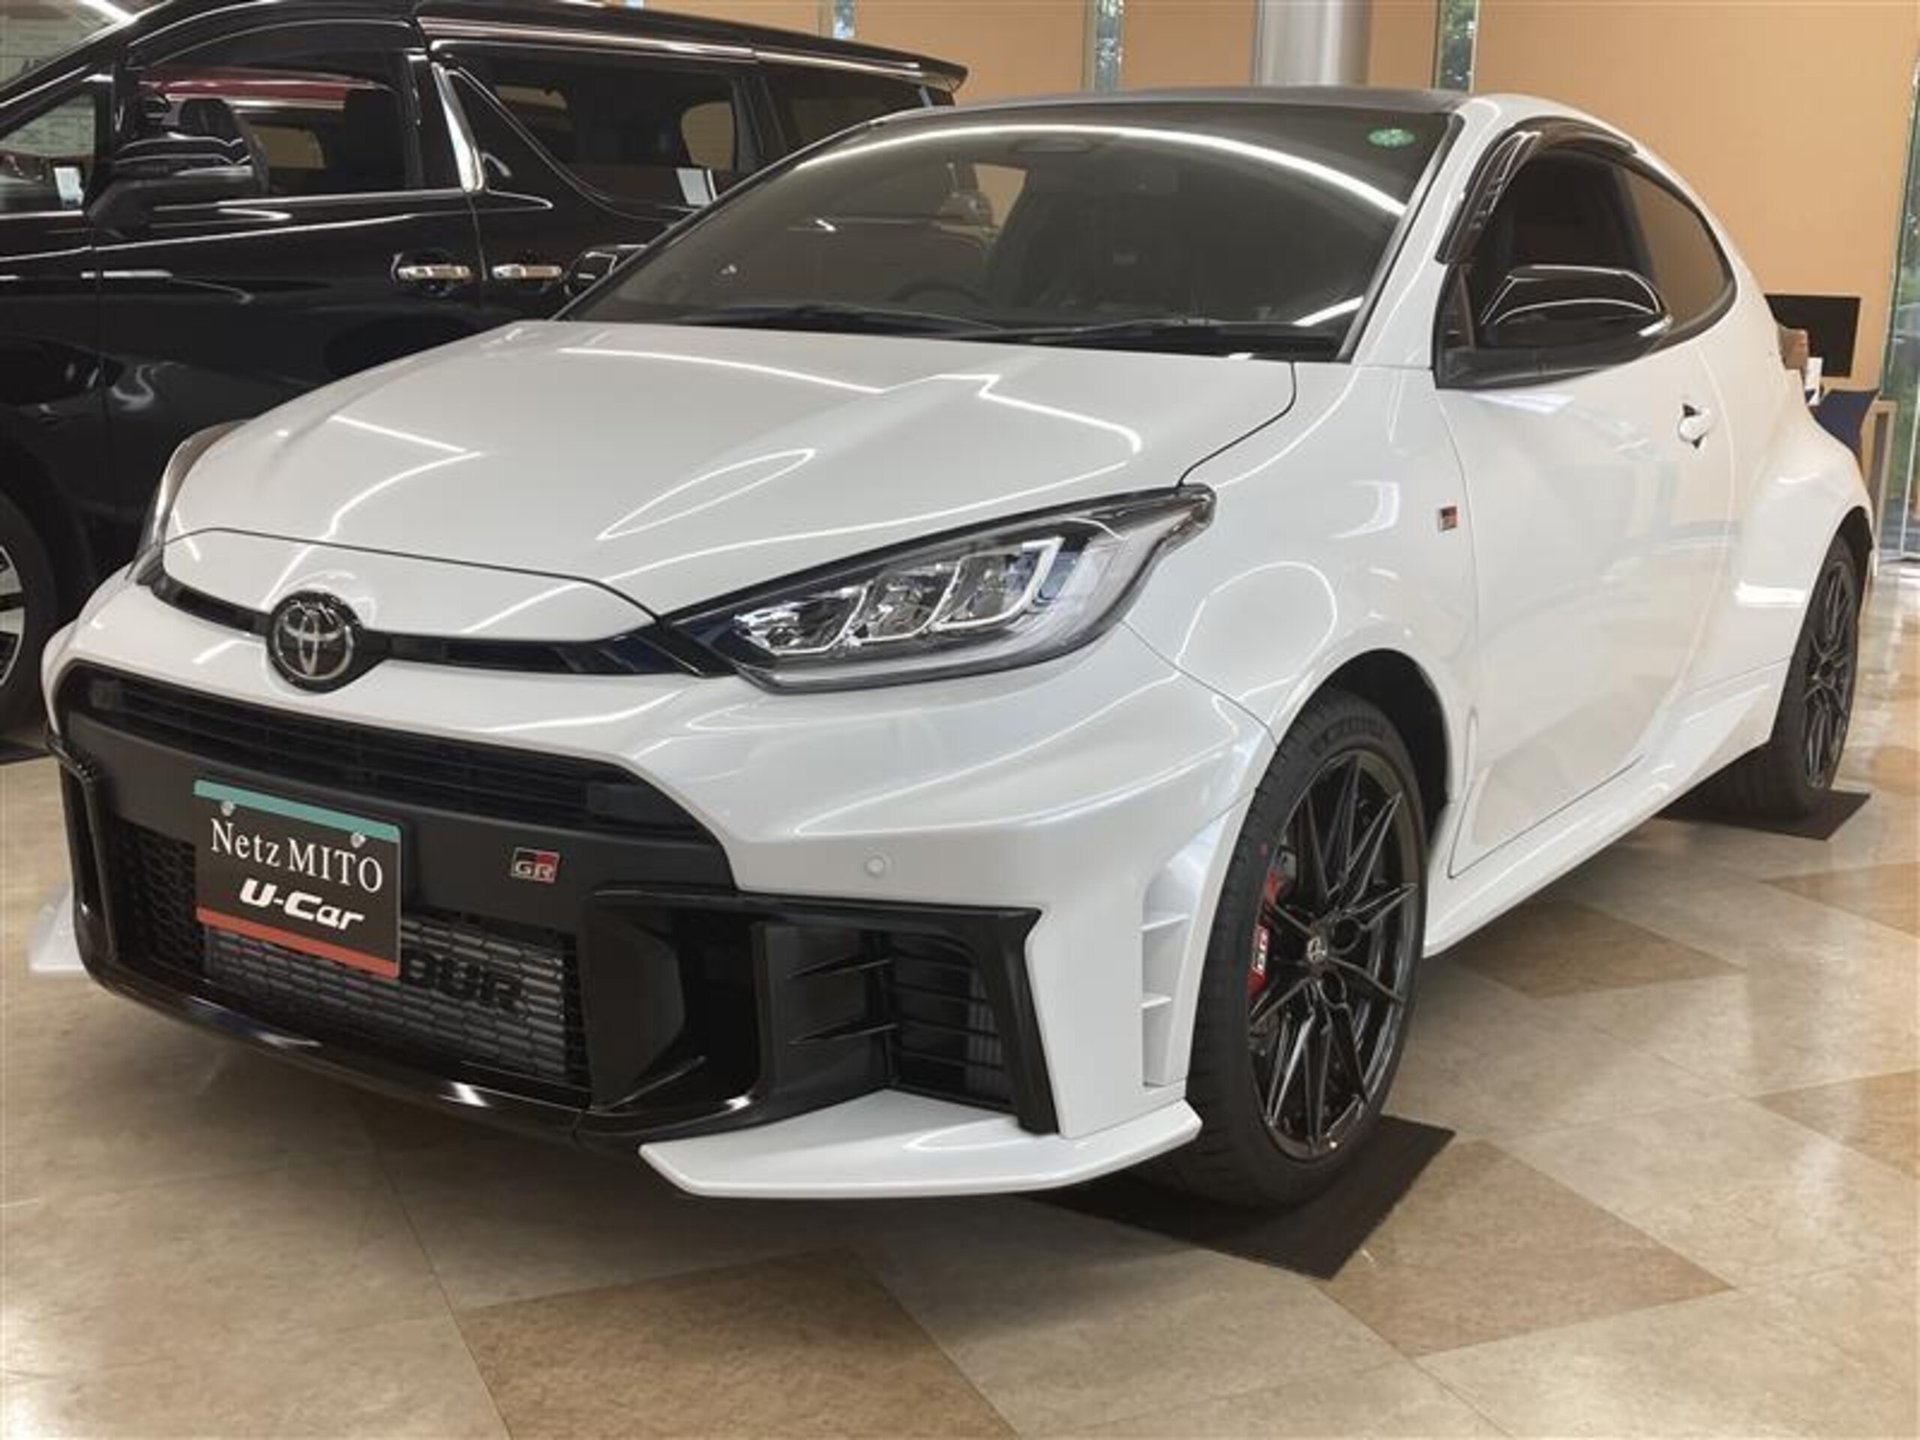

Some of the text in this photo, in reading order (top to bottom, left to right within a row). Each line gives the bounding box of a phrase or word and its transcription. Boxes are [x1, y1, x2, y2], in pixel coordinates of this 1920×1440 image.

[211, 818, 383, 893] Netz MITO
[513, 859, 556, 882] GR
[239, 877, 366, 930] U-Car
